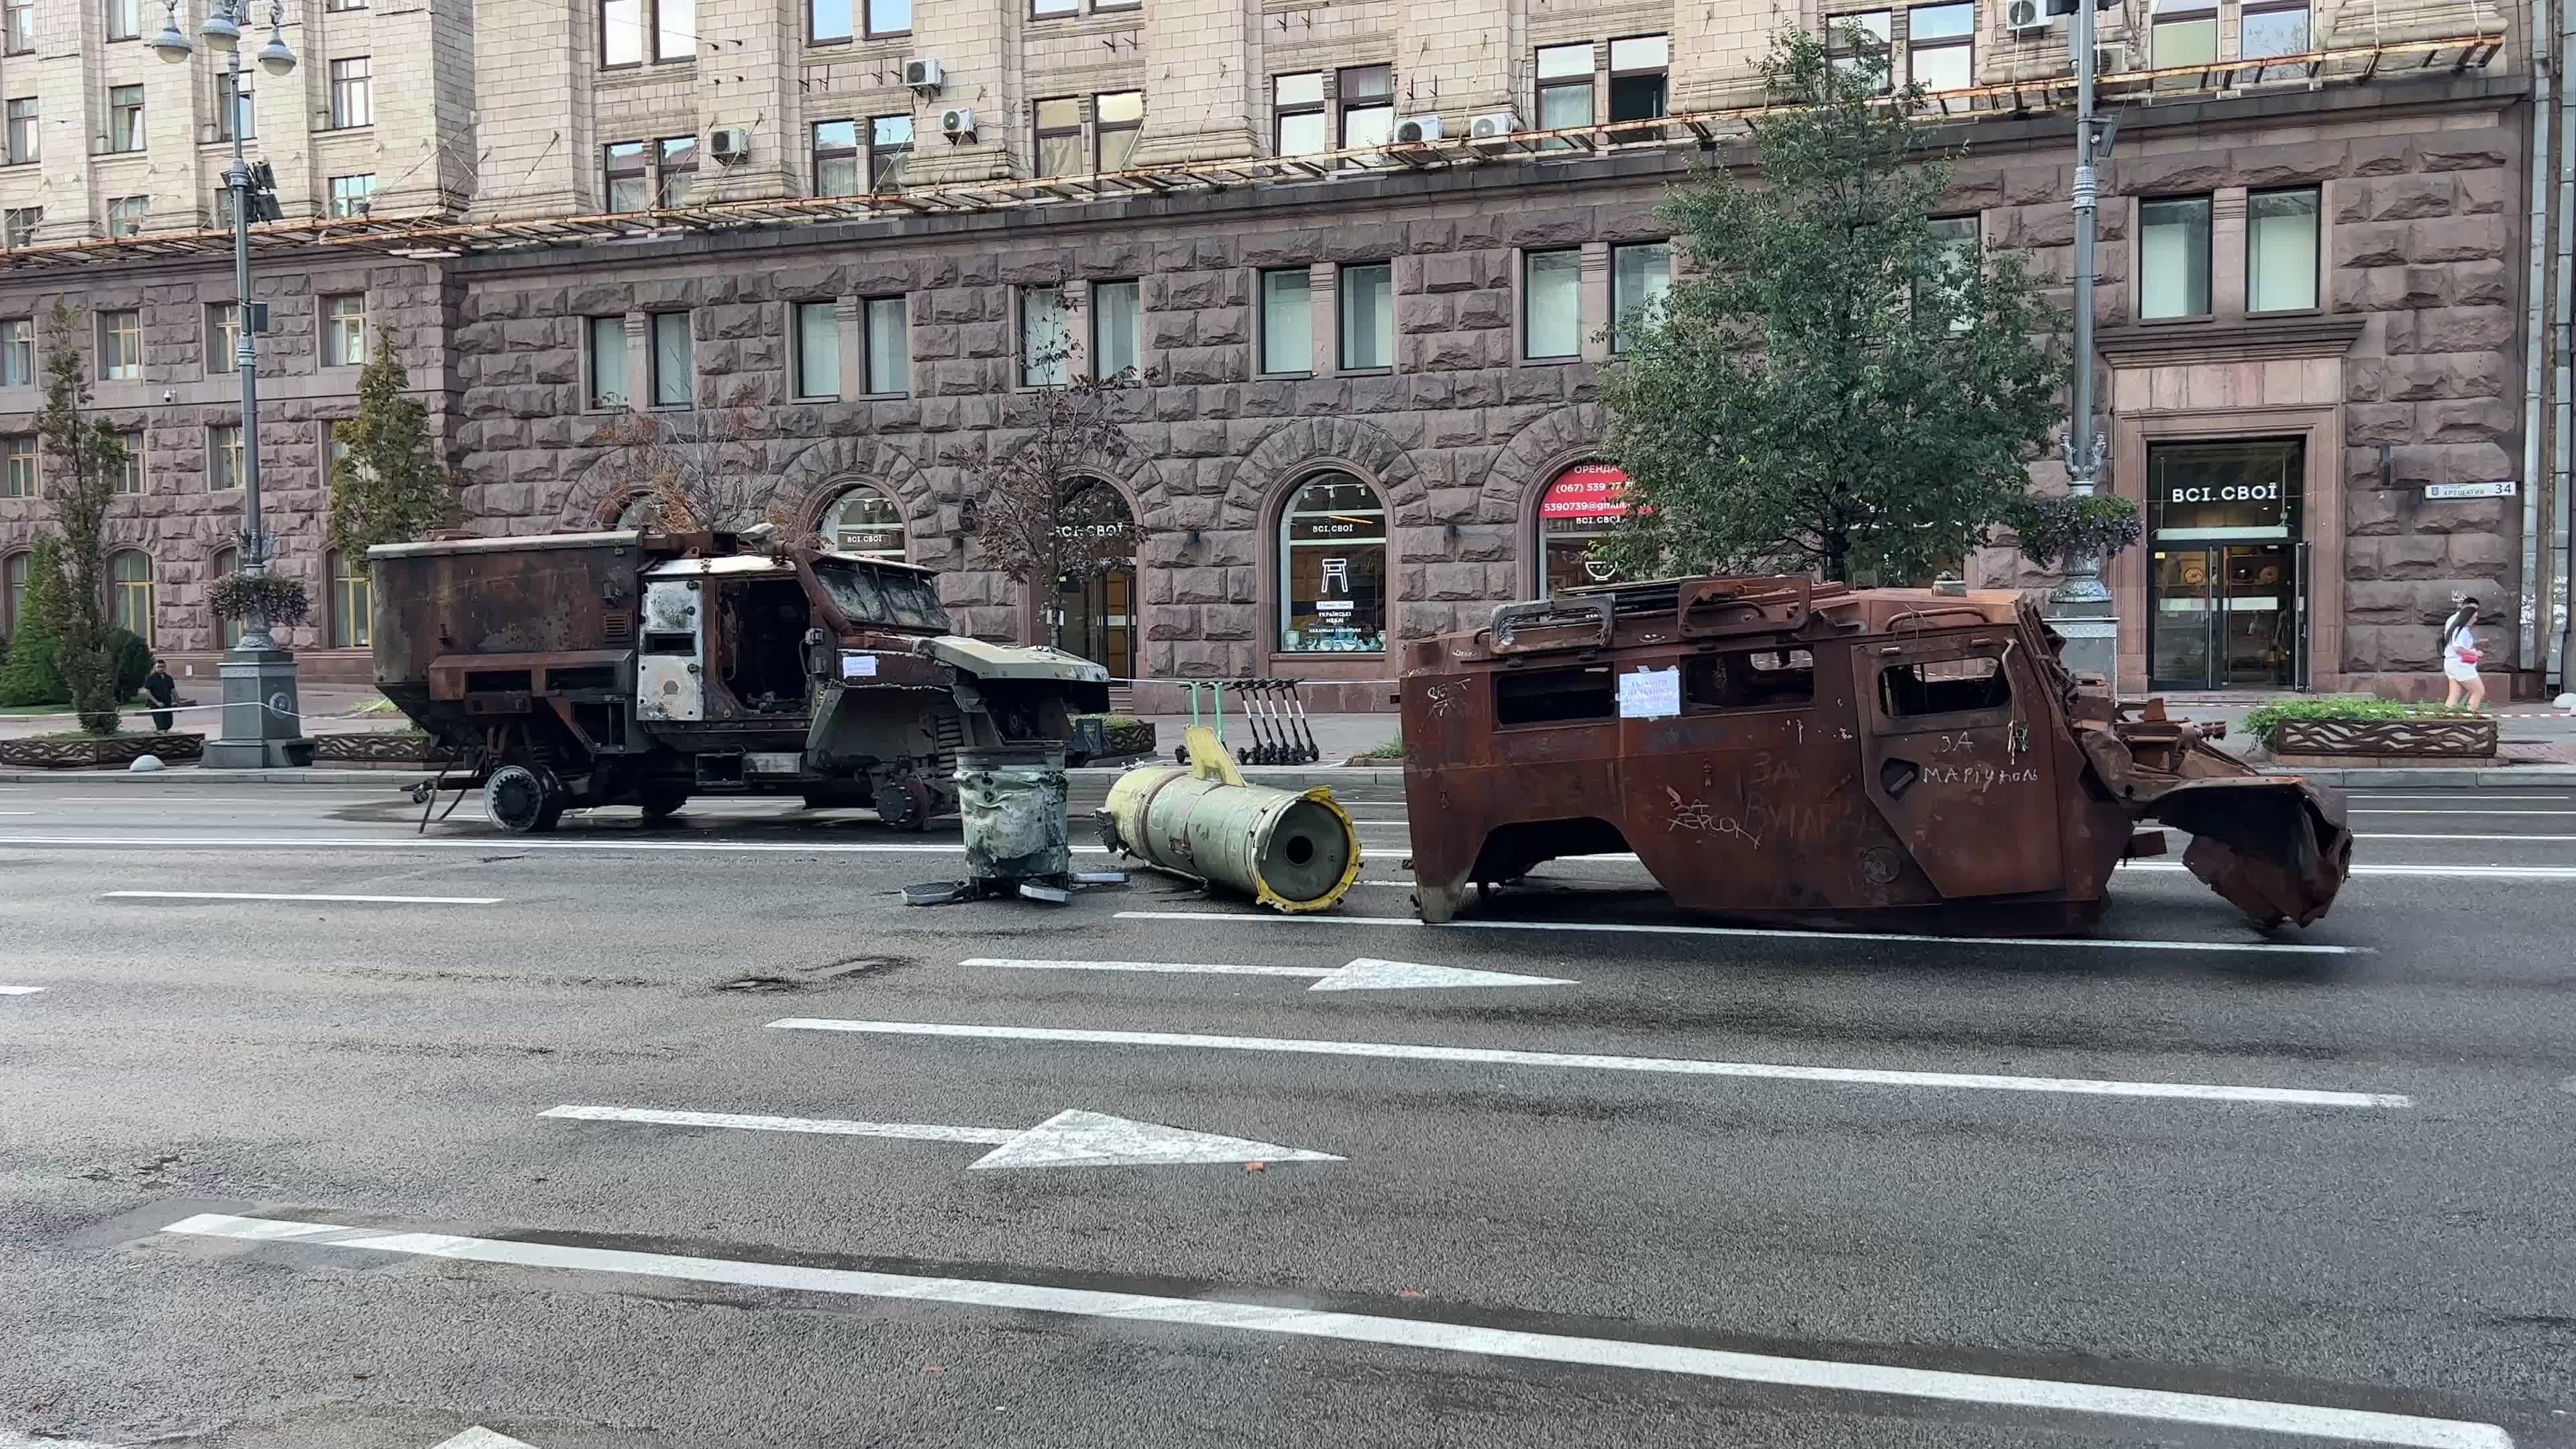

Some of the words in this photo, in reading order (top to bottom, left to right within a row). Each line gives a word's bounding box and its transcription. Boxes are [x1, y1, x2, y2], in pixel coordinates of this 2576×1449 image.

[1574, 464, 1619, 474] ОРЕНДА
[1556, 483, 1584, 494] (067)
[1587, 482, 1605, 491] 539
[2172, 487, 2216, 502] ВСІ.
[2221, 482, 2277, 500] СВОЇ
[2494, 484, 2512, 494] 34
[1331, 524, 1353, 532] СВОЇ
[1941, 731, 1974, 753] ЗА
